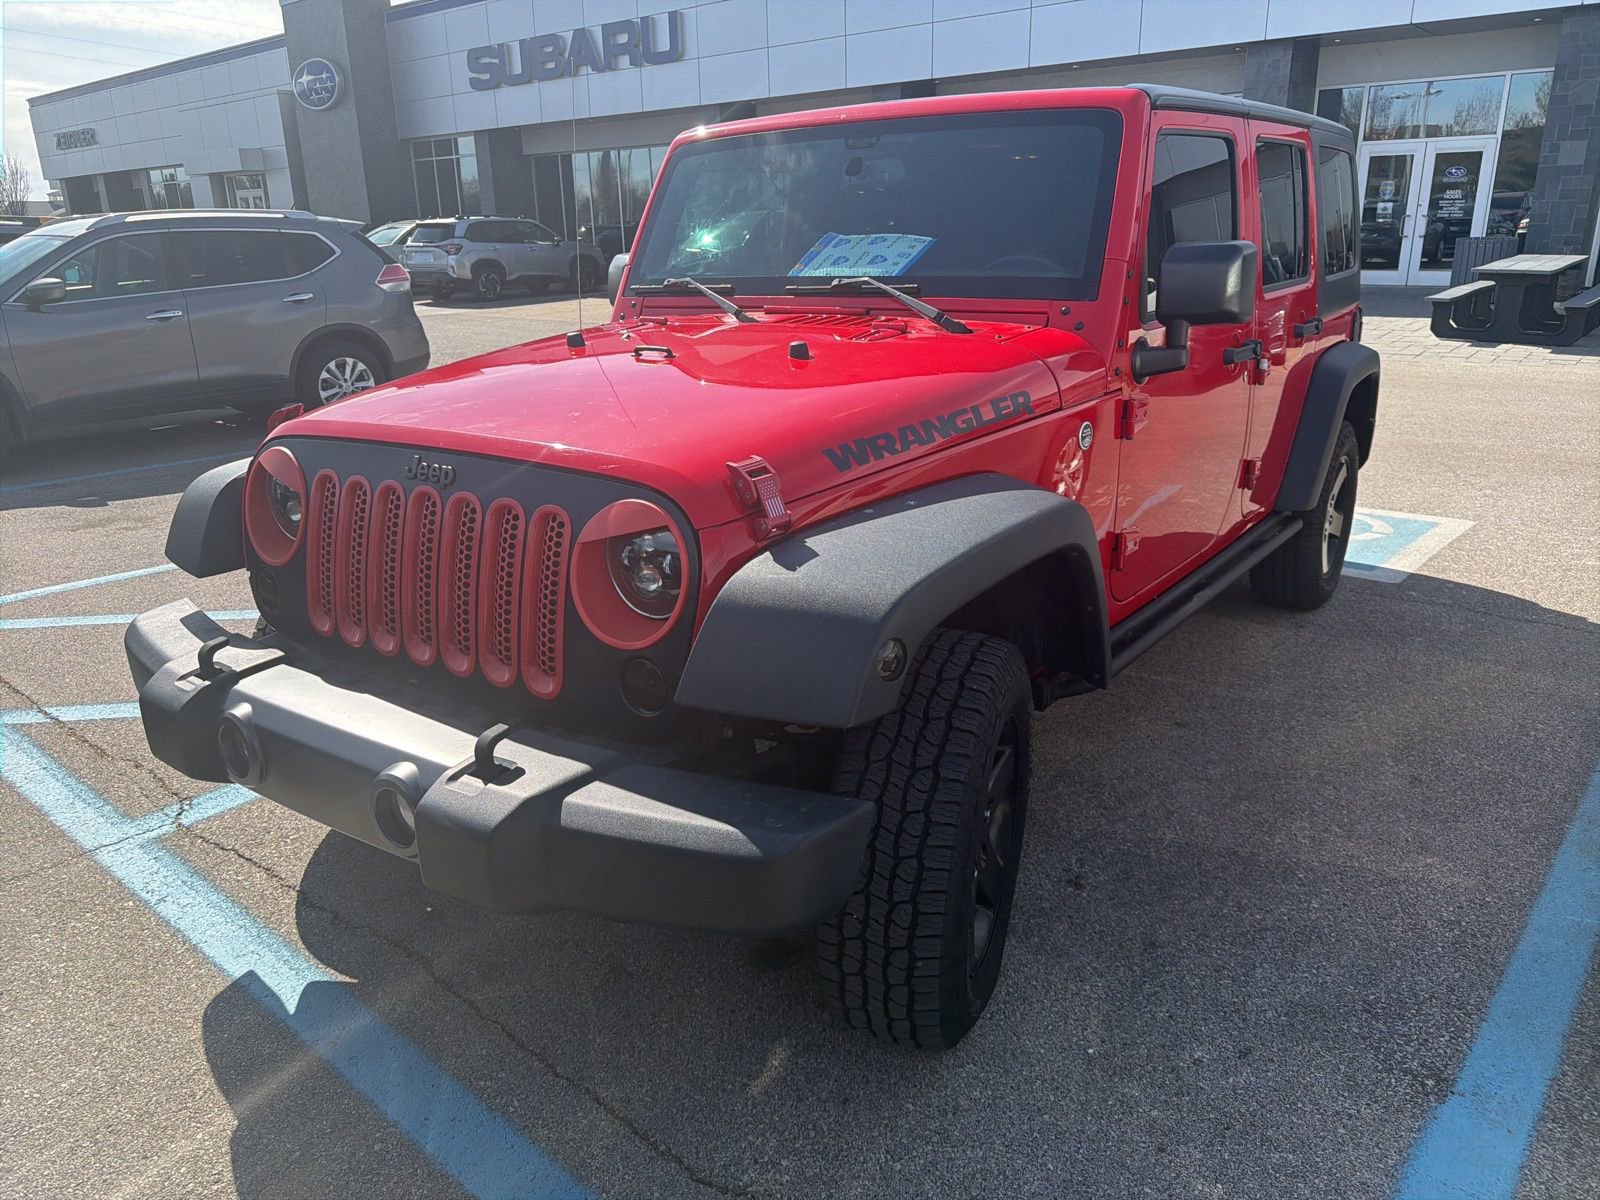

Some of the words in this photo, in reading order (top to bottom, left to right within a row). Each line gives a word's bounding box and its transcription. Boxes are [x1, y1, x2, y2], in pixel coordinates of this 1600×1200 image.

[467, 10, 682, 91] SUBARU
[54, 128, 98, 150] ZEIGLER
[822, 390, 1036, 473] WRANGLER
[404, 455, 456, 489] Jeep
